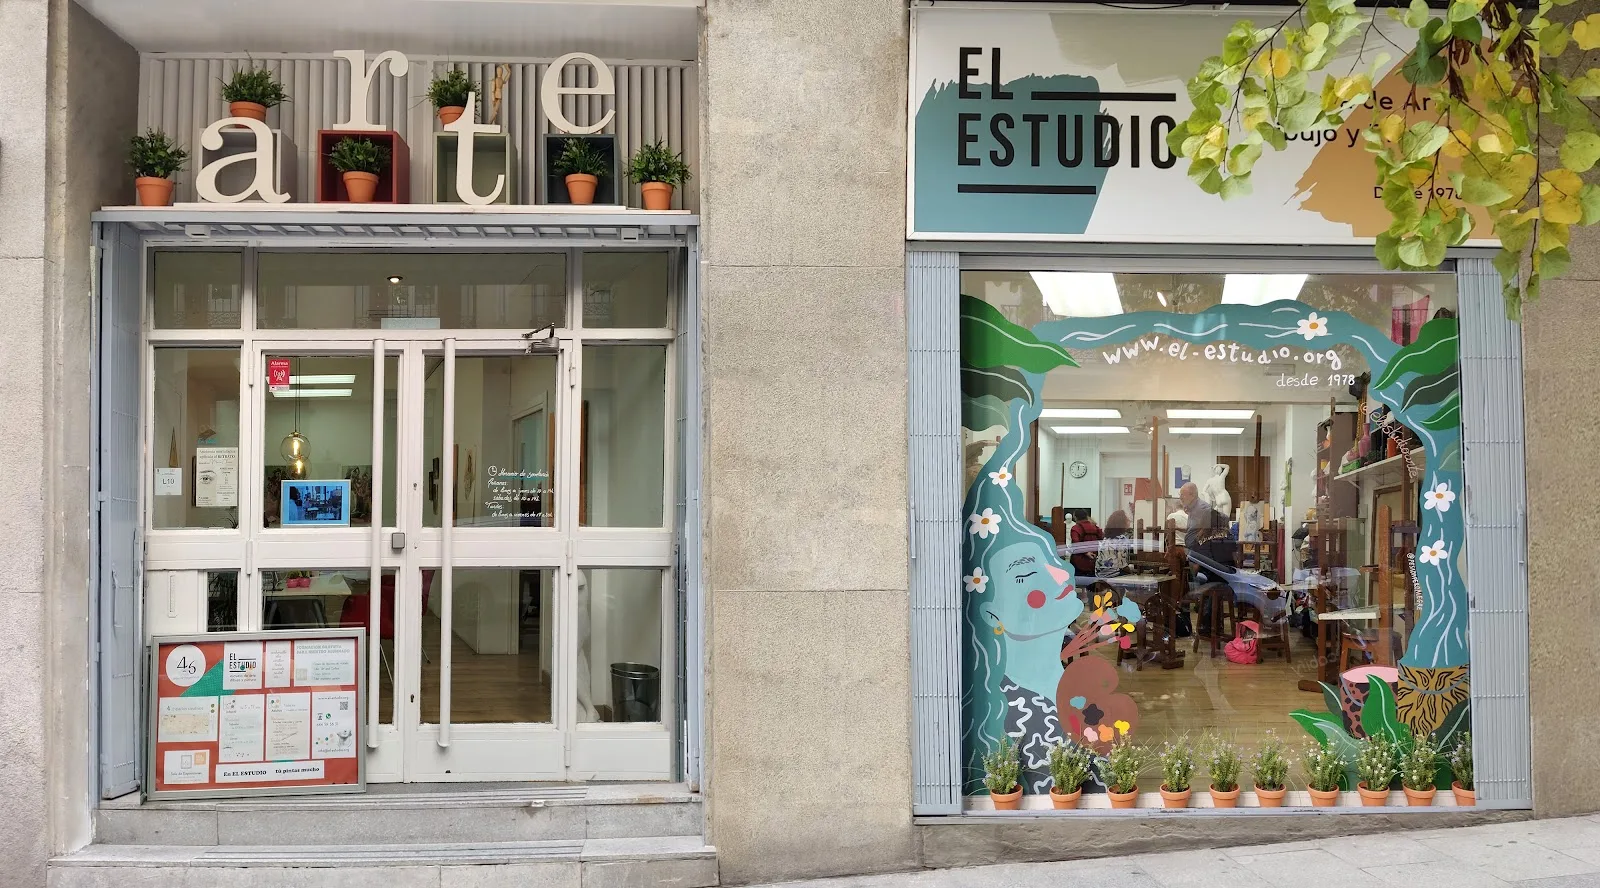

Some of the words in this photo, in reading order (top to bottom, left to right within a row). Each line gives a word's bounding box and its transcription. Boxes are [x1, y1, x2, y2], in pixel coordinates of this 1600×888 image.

[958, 46, 1014, 100] EL
[195, 49, 616, 206] arte
[958, 112, 1177, 170] ESTUDIO
[1346, 128, 1360, 148] y
[1102, 336, 1342, 370] www.el-estudio.org
[1276, 374, 1319, 388] desde
[1328, 374, 1356, 386] 1978
[176, 656, 197, 674] 46
[229, 661, 257, 670] ESTUDIO
